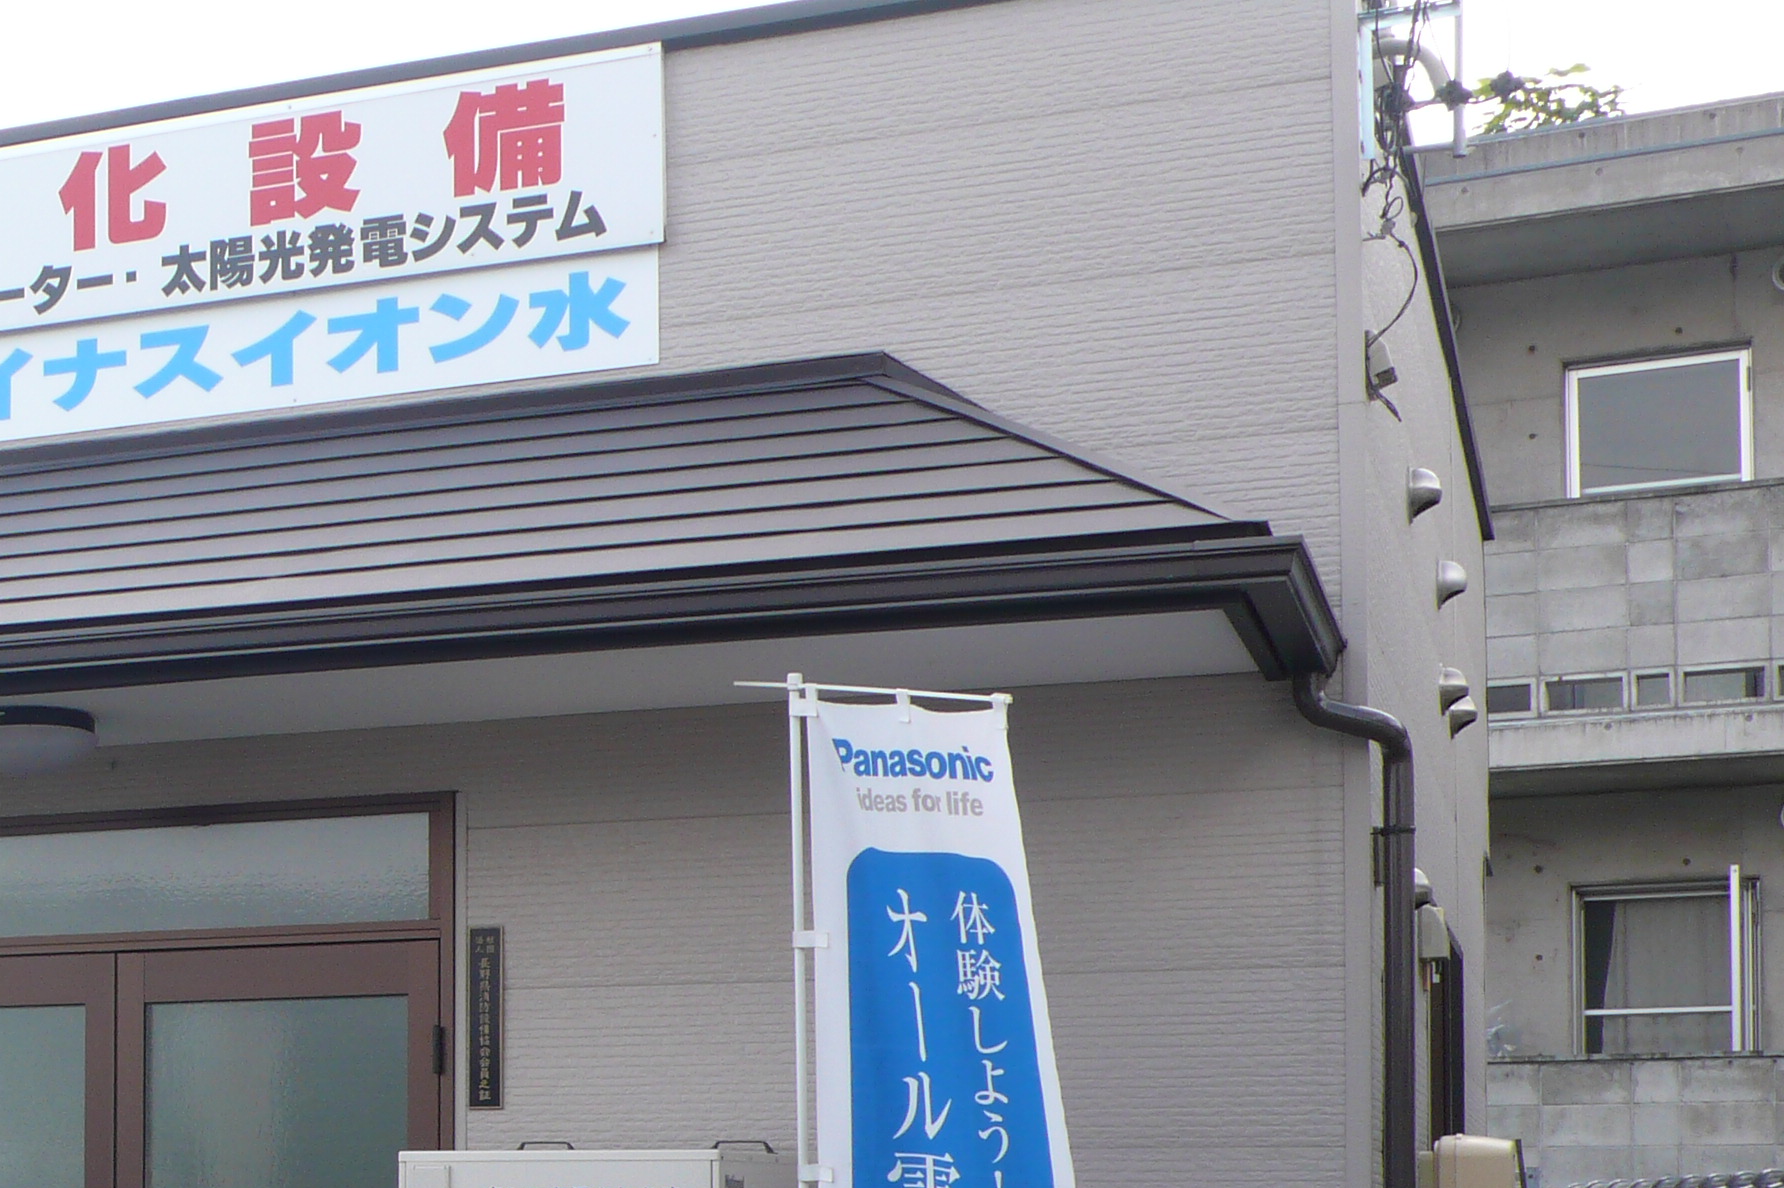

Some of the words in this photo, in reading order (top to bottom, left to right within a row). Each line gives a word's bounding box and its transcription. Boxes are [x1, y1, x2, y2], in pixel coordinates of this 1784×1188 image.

[832, 738, 994, 783] Panasonic
[856, 787, 908, 812] ideas
[912, 787, 942, 812] for
[946, 791, 984, 816] life
